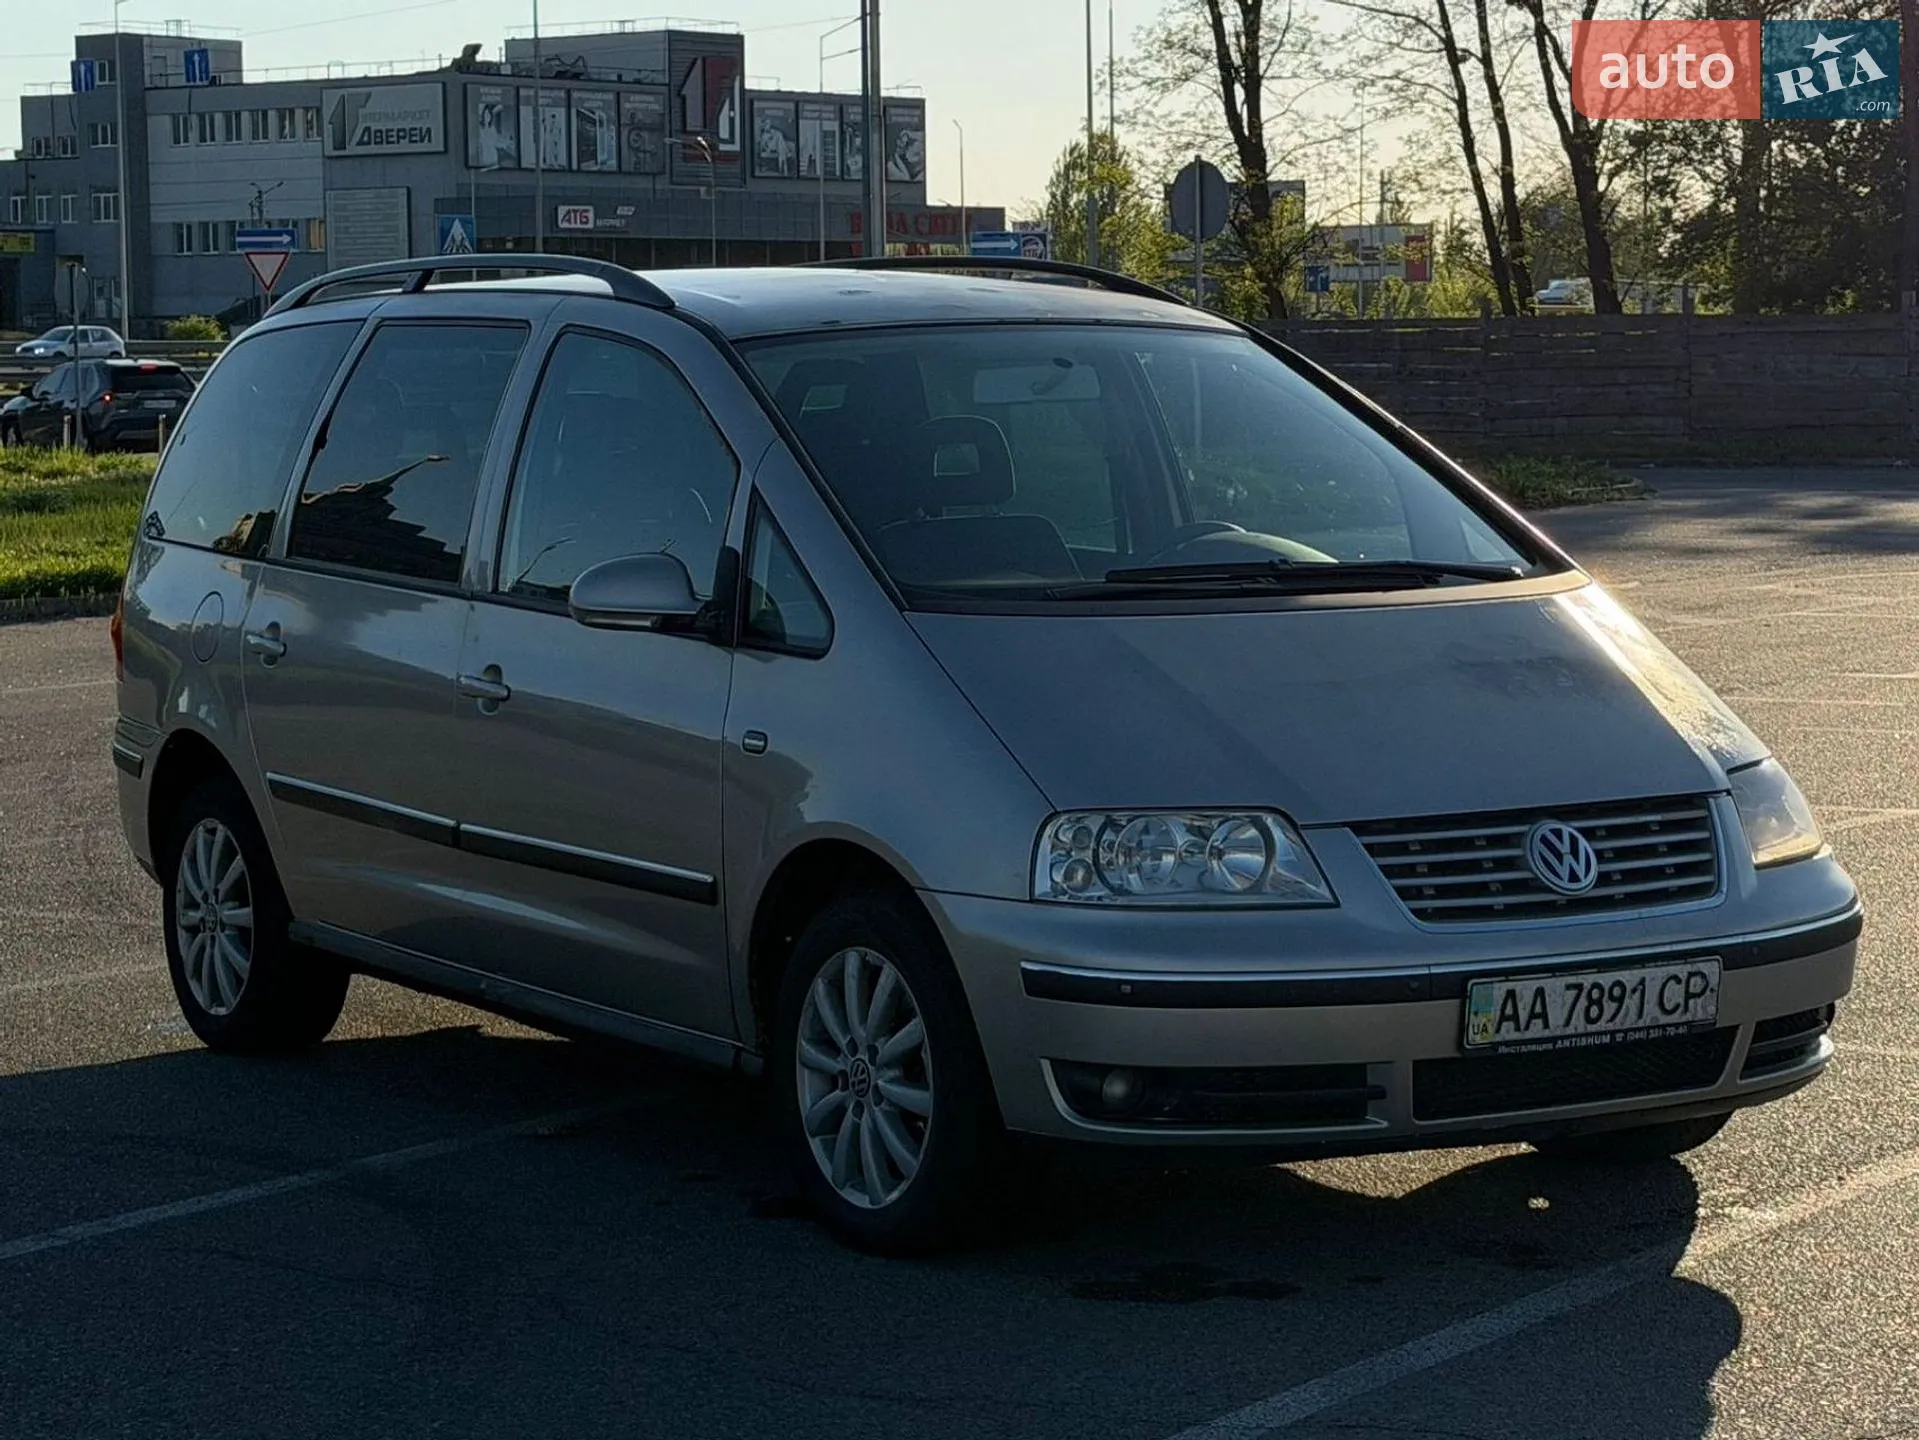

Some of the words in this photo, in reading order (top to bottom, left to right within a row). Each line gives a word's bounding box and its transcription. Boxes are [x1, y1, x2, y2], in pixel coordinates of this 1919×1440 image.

[1495, 986, 1550, 1034] AA
[1563, 977, 1647, 1028] 7891
[1658, 971, 1710, 1016] CP
[1472, 1023, 1489, 1035] UA
